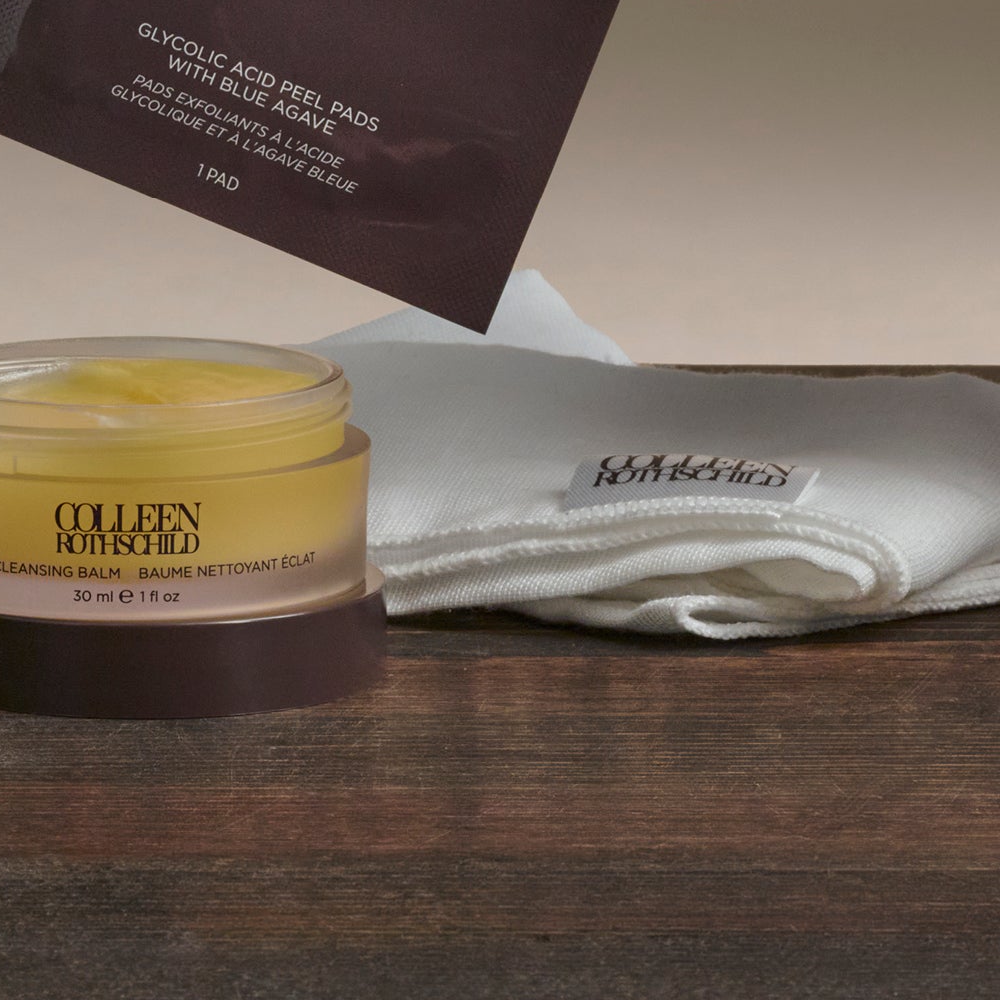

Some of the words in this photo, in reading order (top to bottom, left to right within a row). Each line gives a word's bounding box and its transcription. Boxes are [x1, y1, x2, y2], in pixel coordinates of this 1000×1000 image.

[138, 22, 228, 68] GLYCOLIC
[230, 61, 276, 88] ACID
[280, 80, 323, 110] PEEL
[330, 101, 380, 132] PADS
[169, 54, 216, 86] WITH
[219, 77, 269, 108] BLUE
[271, 100, 337, 136] AGAVE
[132, 74, 174, 99] PADS
[176, 92, 269, 138] EXFOLIANTS
[269, 129, 282, 144] À
[284, 137, 345, 169] L'ACIDE
[111, 84, 206, 130] GLYCOLIQUE
[206, 124, 228, 138] ET
[227, 131, 240, 145] À
[242, 139, 307, 173] L'AGAVE
[307, 166, 359, 194] BLEUE
[197, 163, 205, 177] 1
[206, 167, 240, 191] PAD
[593, 468, 787, 488] ROTHSCHILD
[600, 455, 796, 477] COLLEEN
[55, 501, 201, 533] COLLEEN
[56, 532, 200, 555] ROTHSCHILD
[78, 566, 121, 579] BALM
[138, 566, 193, 579] BAUME
[197, 558, 278, 577] NETTOYANT
[281, 551, 315, 569] ÉCLAT
[73, 590, 91, 602] 30
[97, 590, 113, 602] ml
[139, 591, 145, 602] 1
[150, 590, 158, 602] fl
[163, 592, 180, 602] oz
